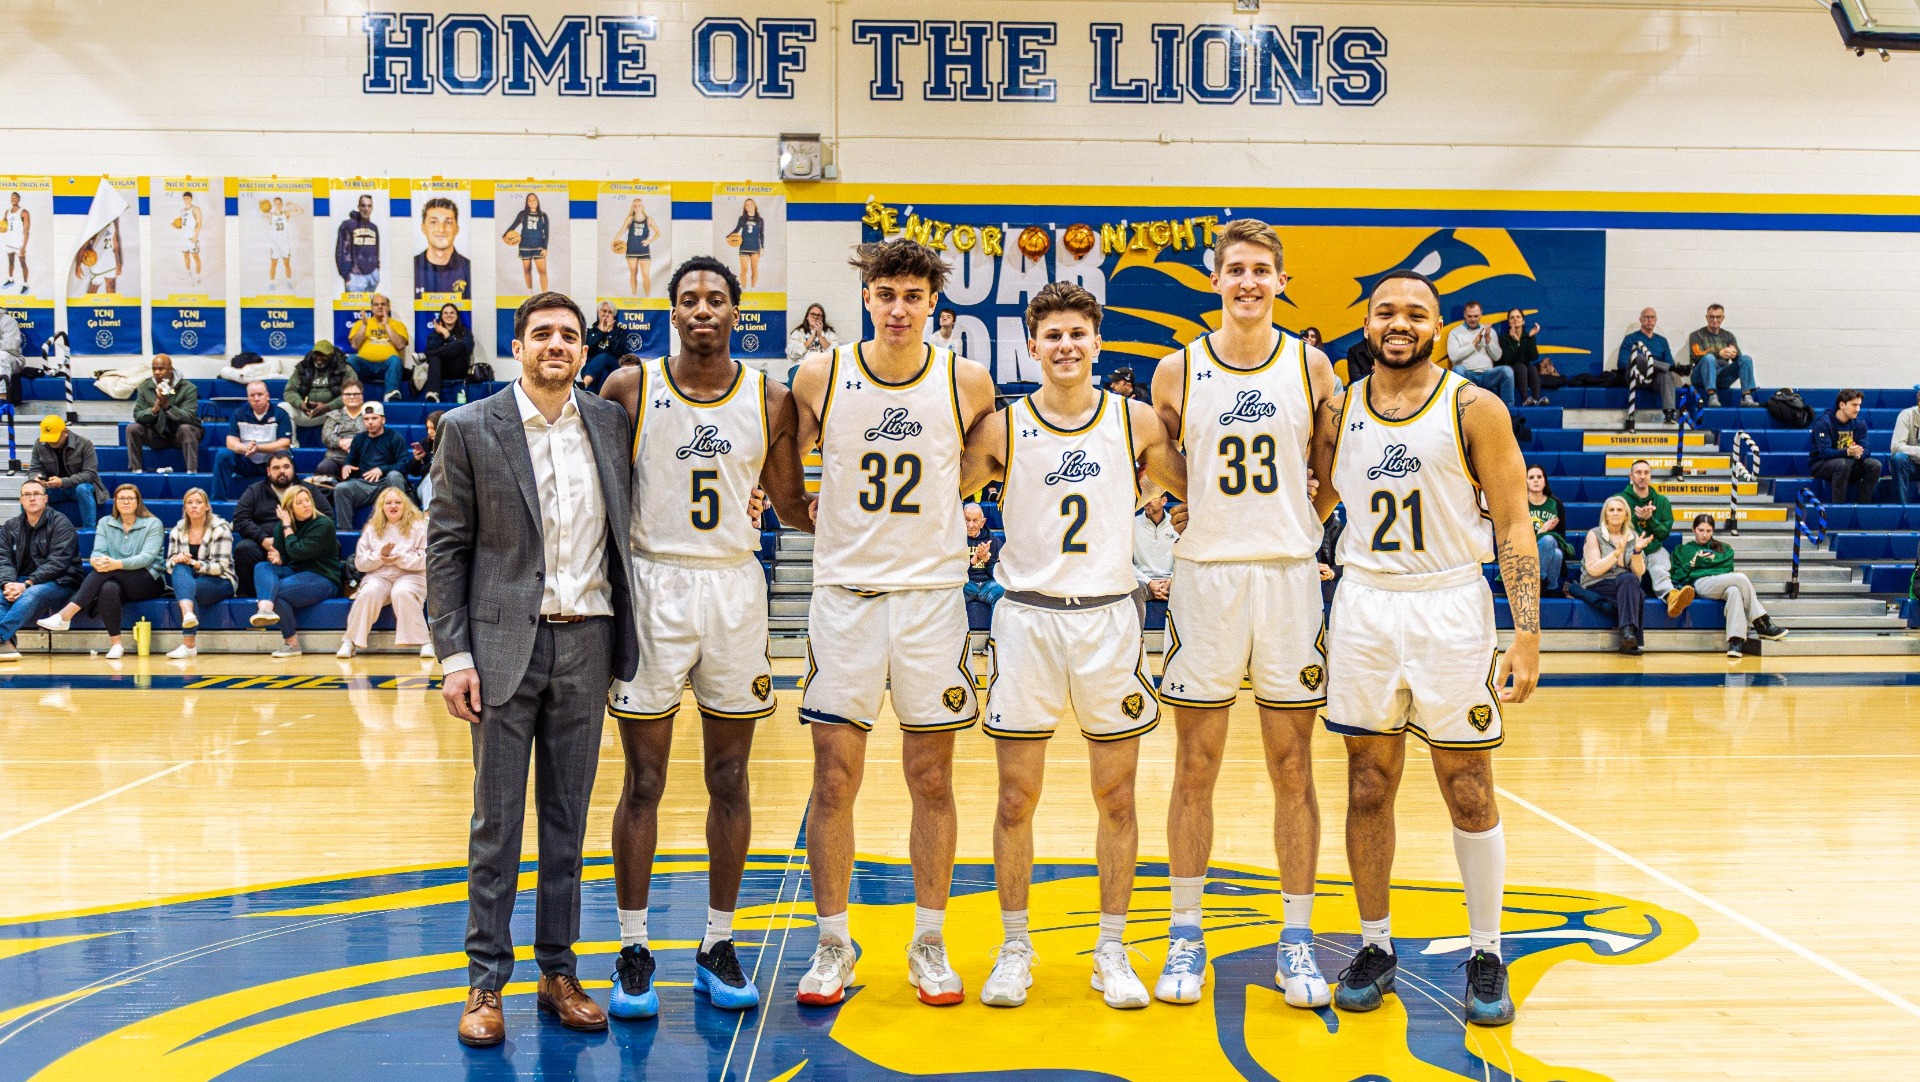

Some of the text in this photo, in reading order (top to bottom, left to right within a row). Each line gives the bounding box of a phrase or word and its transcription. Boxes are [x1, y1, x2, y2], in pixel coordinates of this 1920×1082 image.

[362, 12, 1388, 106] HOME OF THE LIONS
[862, 202, 1003, 256] SENIOR
[1101, 215, 1219, 255] NIGHT
[87, 319, 121, 328] Go Lions!
[94, 309, 115, 318] TCNJ
[172, 320, 206, 329] Go Lions!
[178, 310, 200, 319] TCNJ
[260, 321, 272, 329] Go
[267, 310, 288, 320] TCNJ
[623, 312, 644, 322] TCNJ
[628, 322, 651, 331] Lions!
[733, 323, 767, 332] Go Lions!
[740, 313, 761, 323] TCNJ
[863, 407, 922, 441] Lions
[1219, 389, 1277, 426] Lions
[676, 425, 732, 460] Lions
[1045, 450, 1100, 486] Lions
[1217, 433, 1278, 496] 33
[1367, 443, 1421, 480] Lions
[690, 468, 721, 532] 5
[858, 451, 922, 515] 32
[1059, 493, 1088, 554] 2
[1370, 488, 1425, 553] 21
[183, 675, 354, 689] THE
